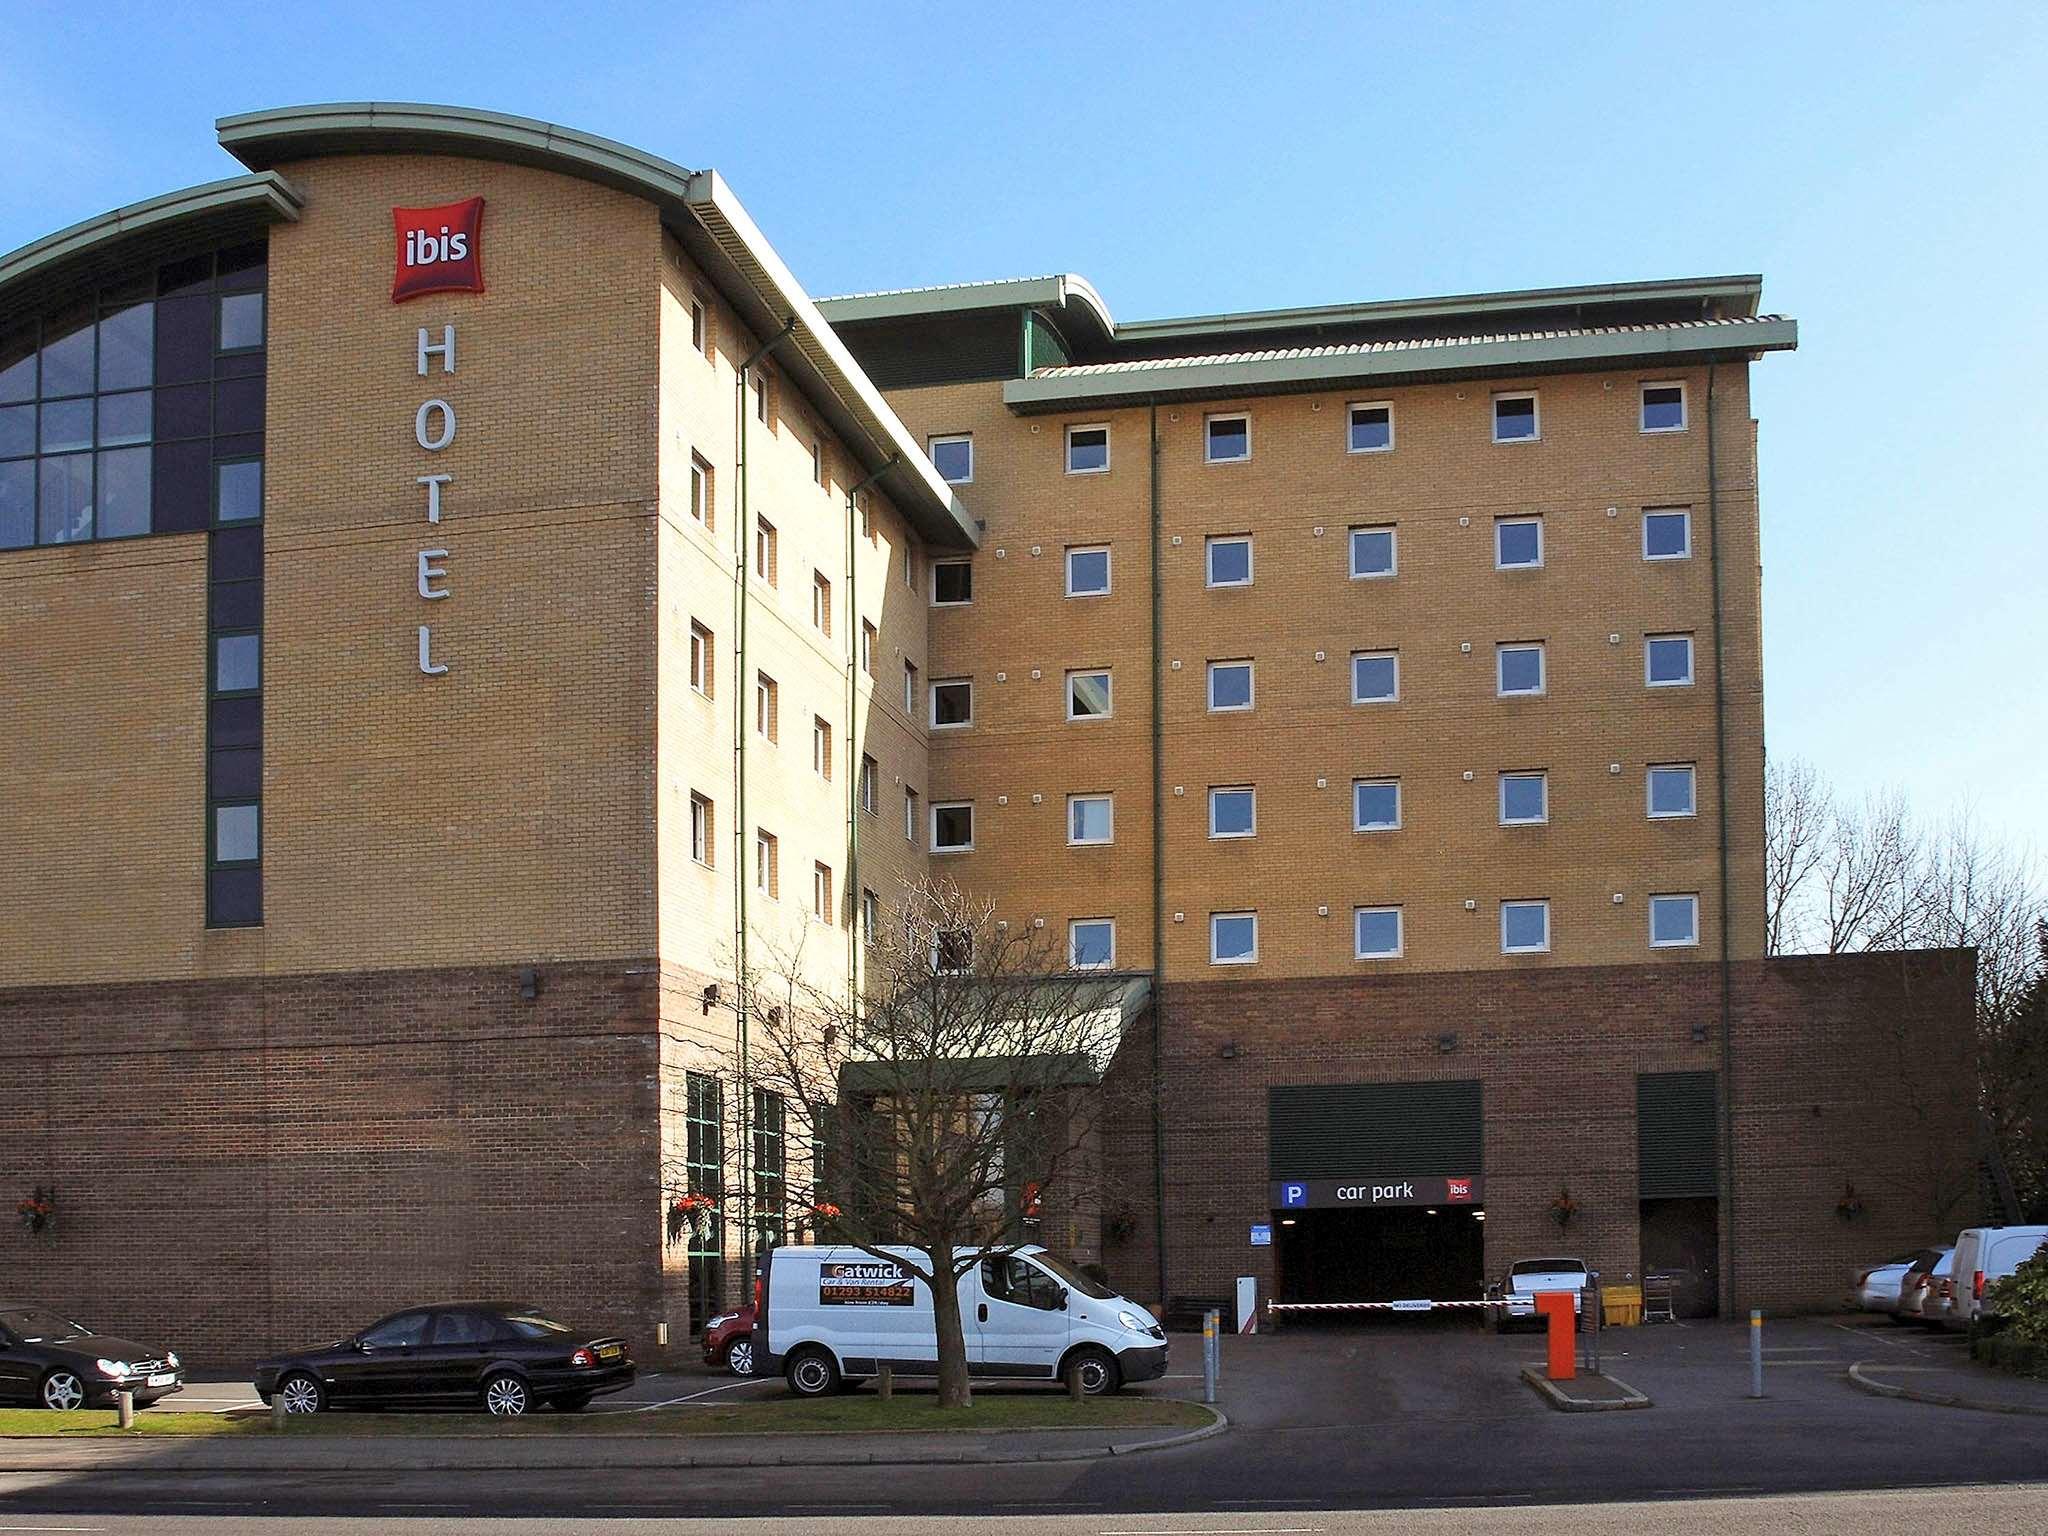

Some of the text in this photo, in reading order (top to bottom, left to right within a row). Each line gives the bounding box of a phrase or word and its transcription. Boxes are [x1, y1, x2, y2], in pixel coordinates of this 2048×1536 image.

[406, 226, 468, 266] ibis
[415, 324, 456, 674] HOTEL
[1288, 1186, 1303, 1204] P
[1336, 1181, 1414, 1203] car park
[1450, 1184, 1469, 1194] ibis
[832, 1264, 903, 1278] Gatwick
[823, 1287, 911, 1297] 01293 514822
